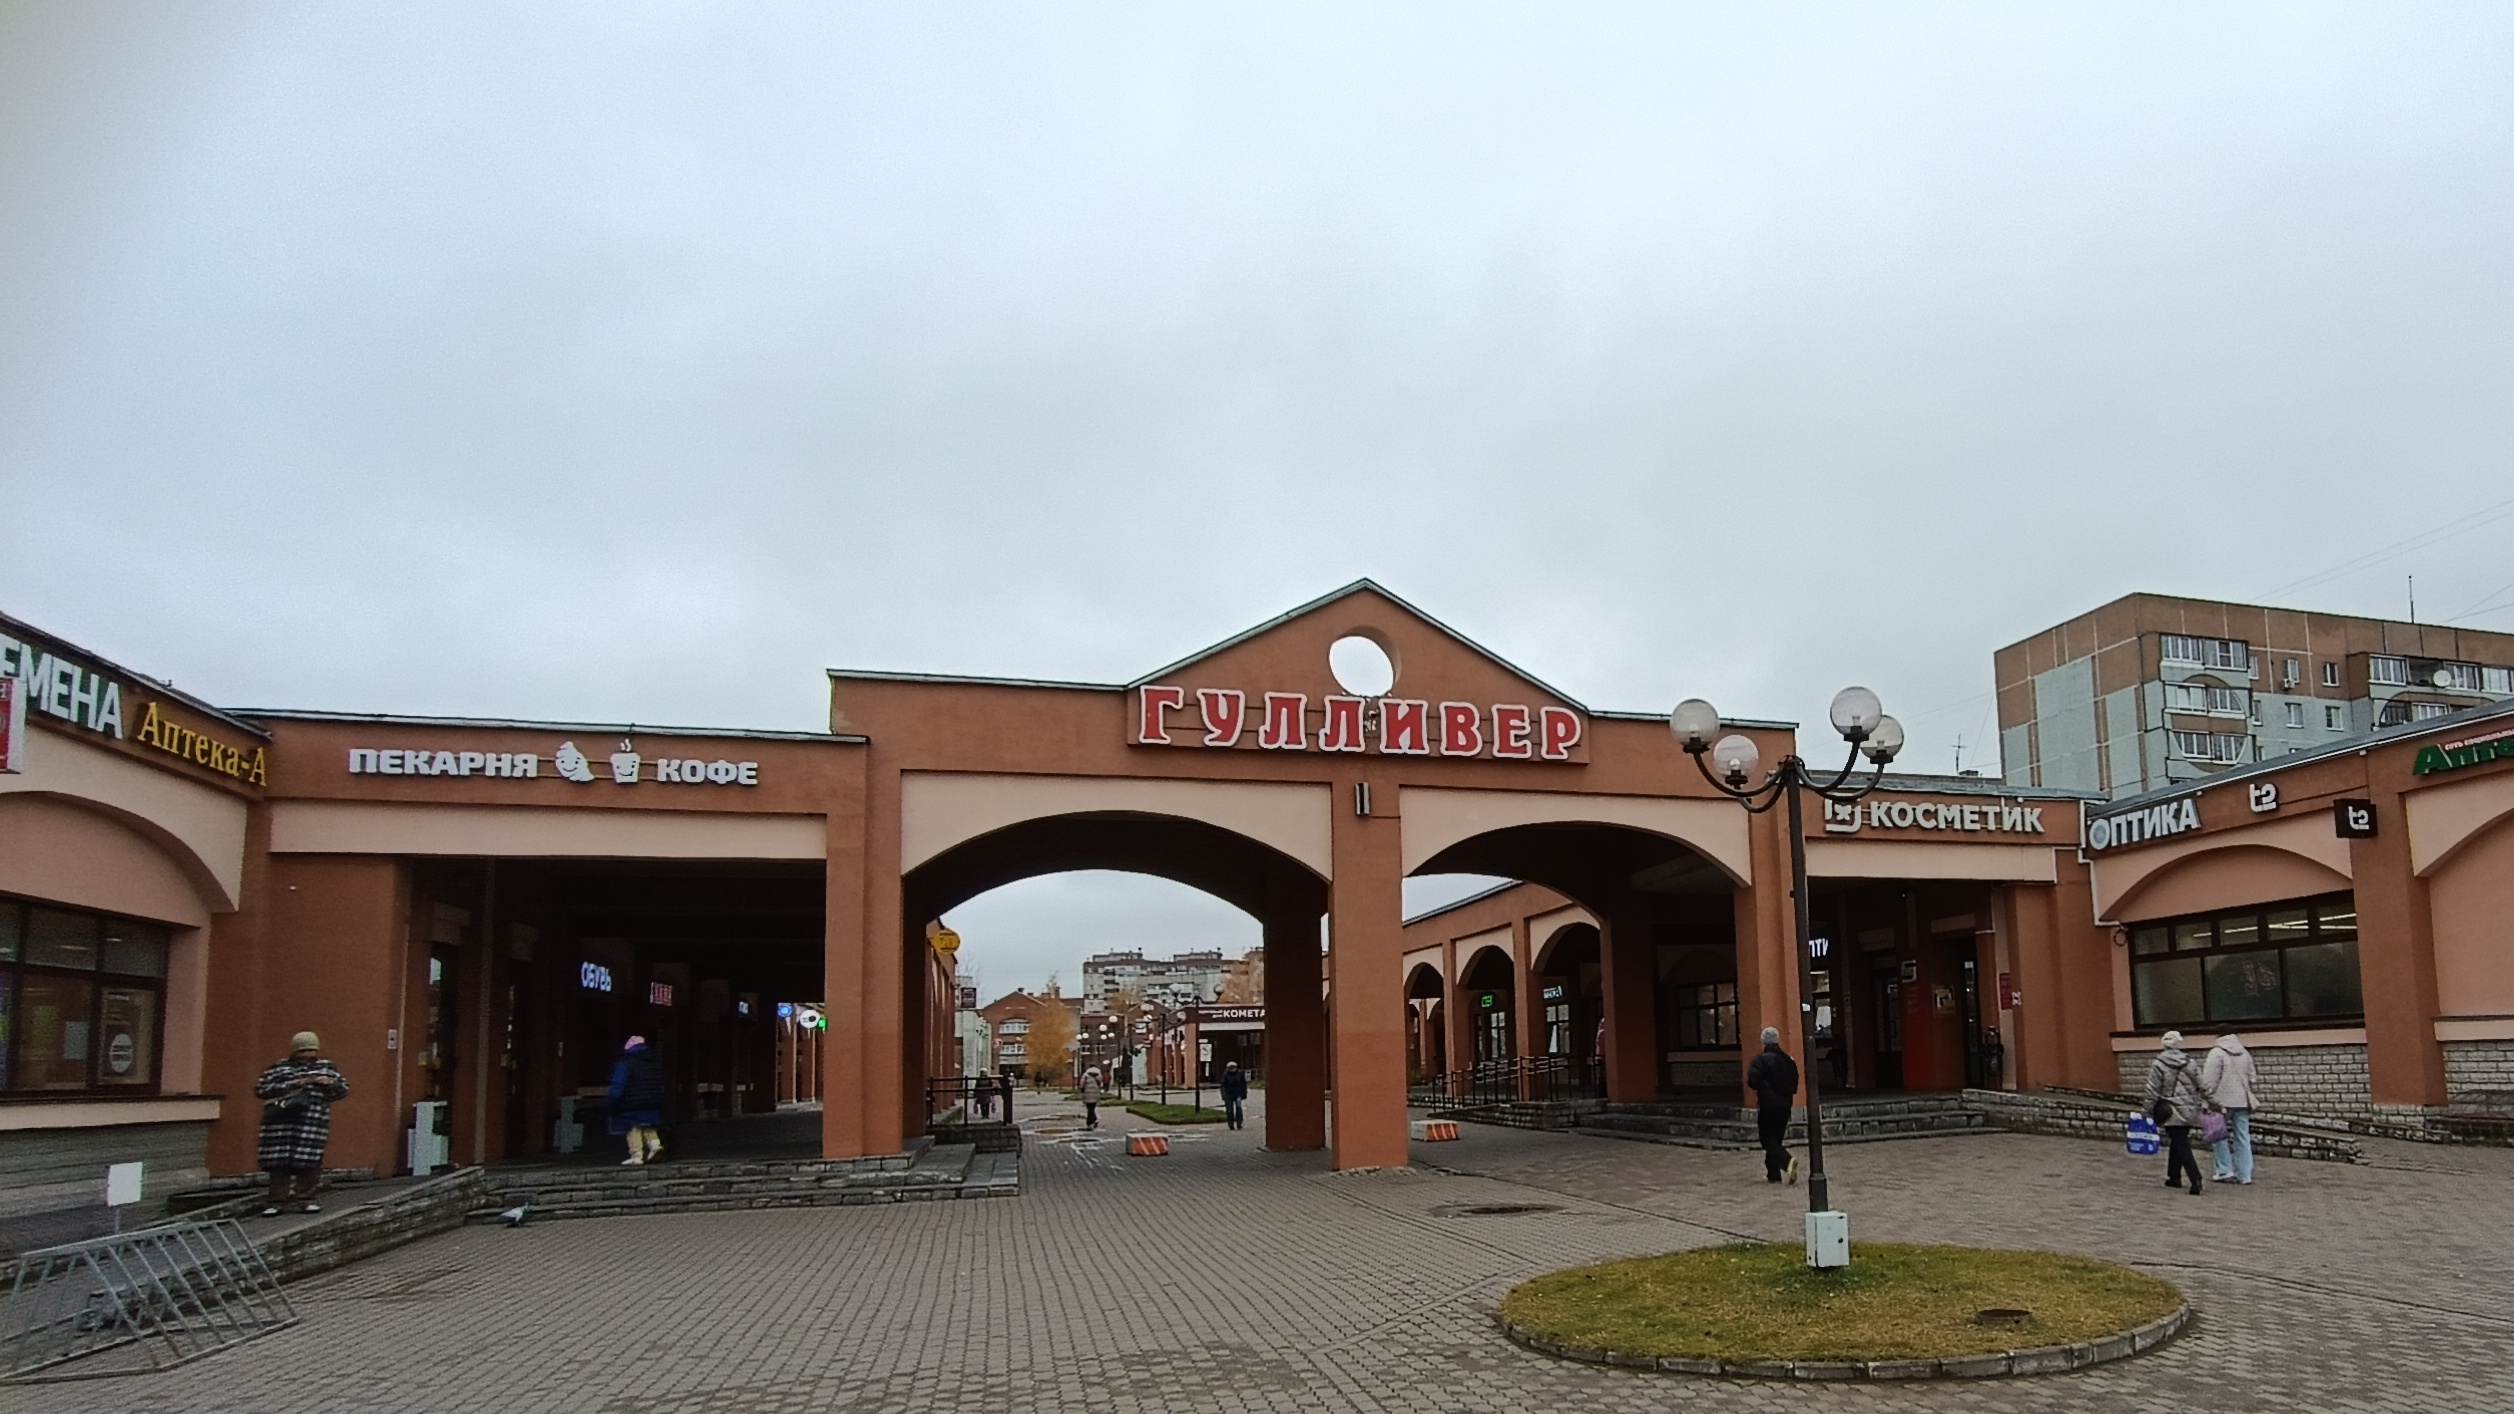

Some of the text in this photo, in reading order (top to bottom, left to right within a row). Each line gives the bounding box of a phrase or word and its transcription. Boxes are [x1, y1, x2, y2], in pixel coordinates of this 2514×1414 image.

[1138, 685, 1582, 760] ГУЛЛИВЕР
[138, 701, 267, 786] Аптека-А
[349, 748, 759, 785] ПЕКАРНЯ КОФЕ
[2250, 783, 2277, 812] t2
[1870, 801, 2045, 832] КОСМЕТИК
[2089, 799, 2199, 850] ОПТИКА
[2347, 806, 2370, 830] t2
[581, 961, 612, 991] ОБУВЬ
